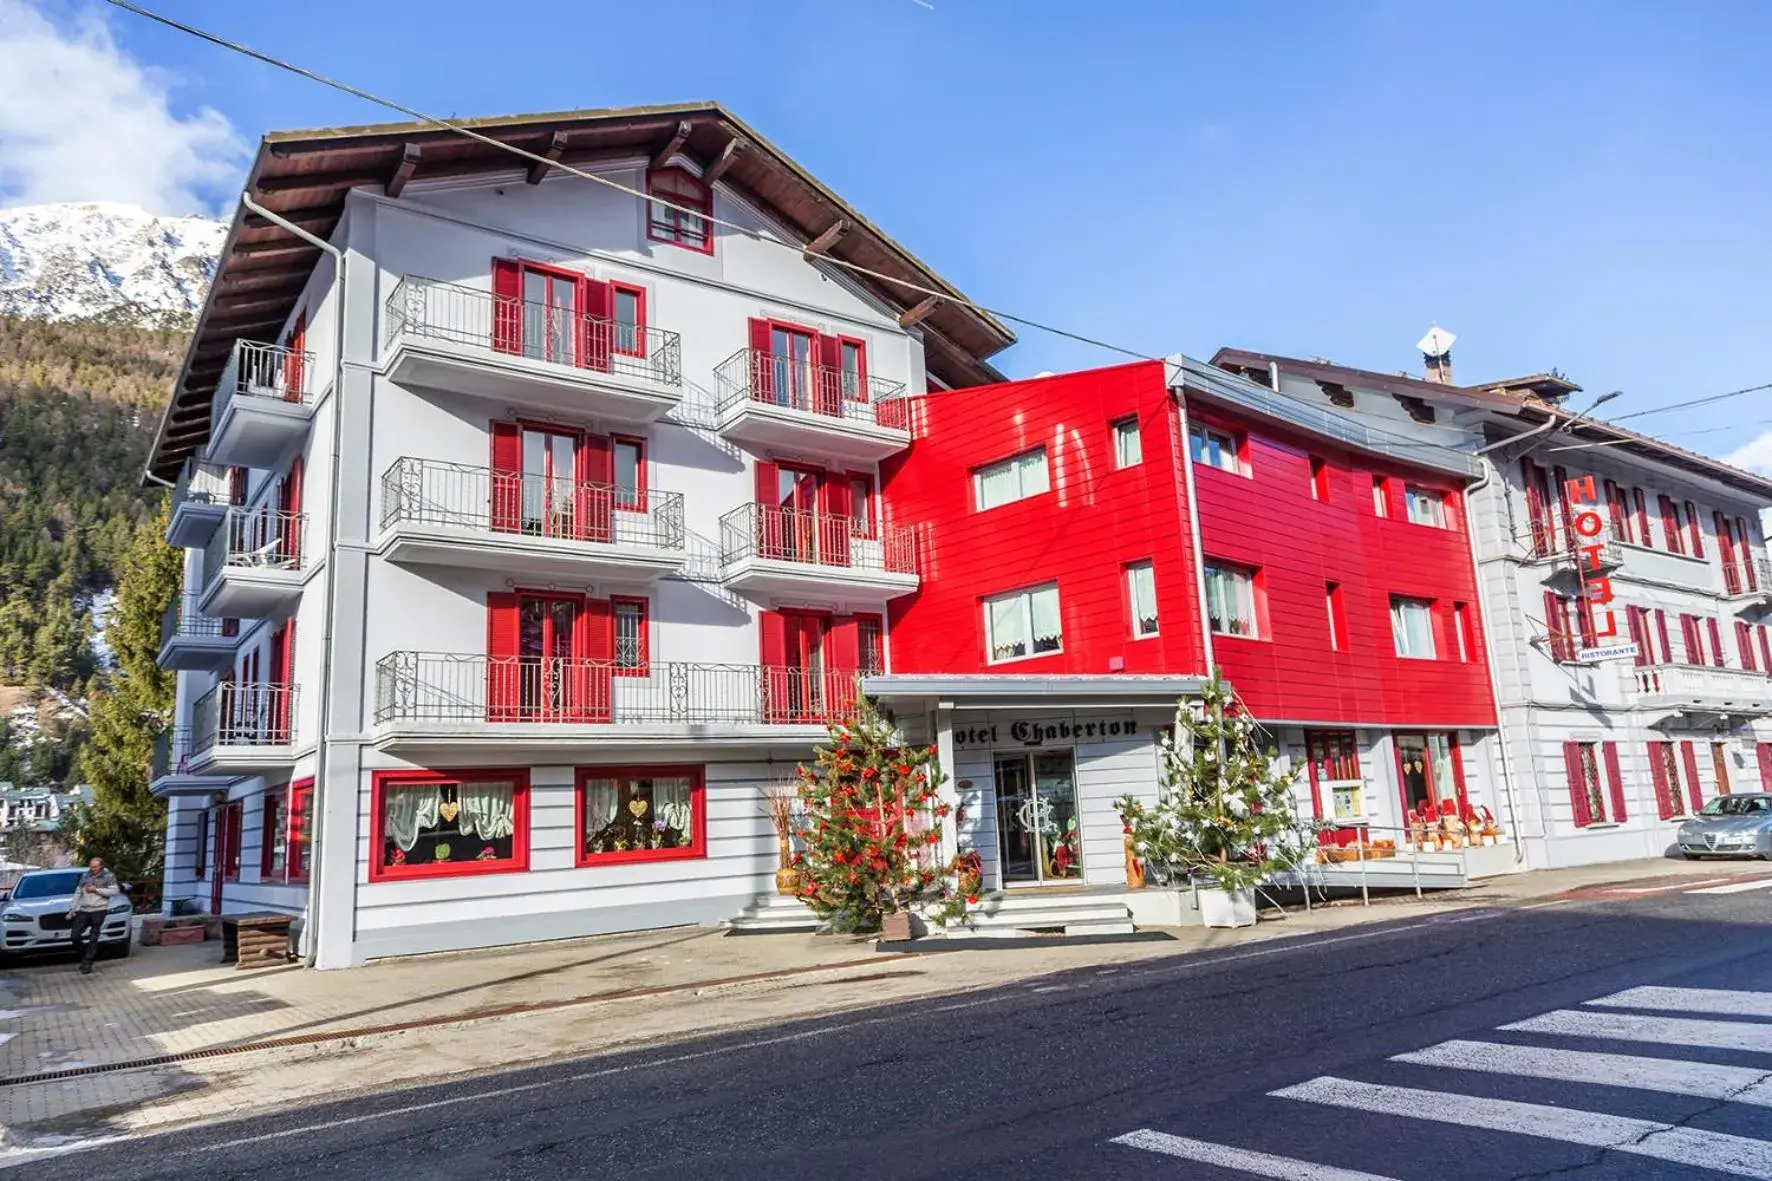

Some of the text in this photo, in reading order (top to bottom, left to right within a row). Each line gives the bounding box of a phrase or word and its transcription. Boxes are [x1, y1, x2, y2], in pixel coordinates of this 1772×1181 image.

[1581, 646, 1637, 659] RISTORANTE
[936, 719, 1138, 746] otel Chaberton
